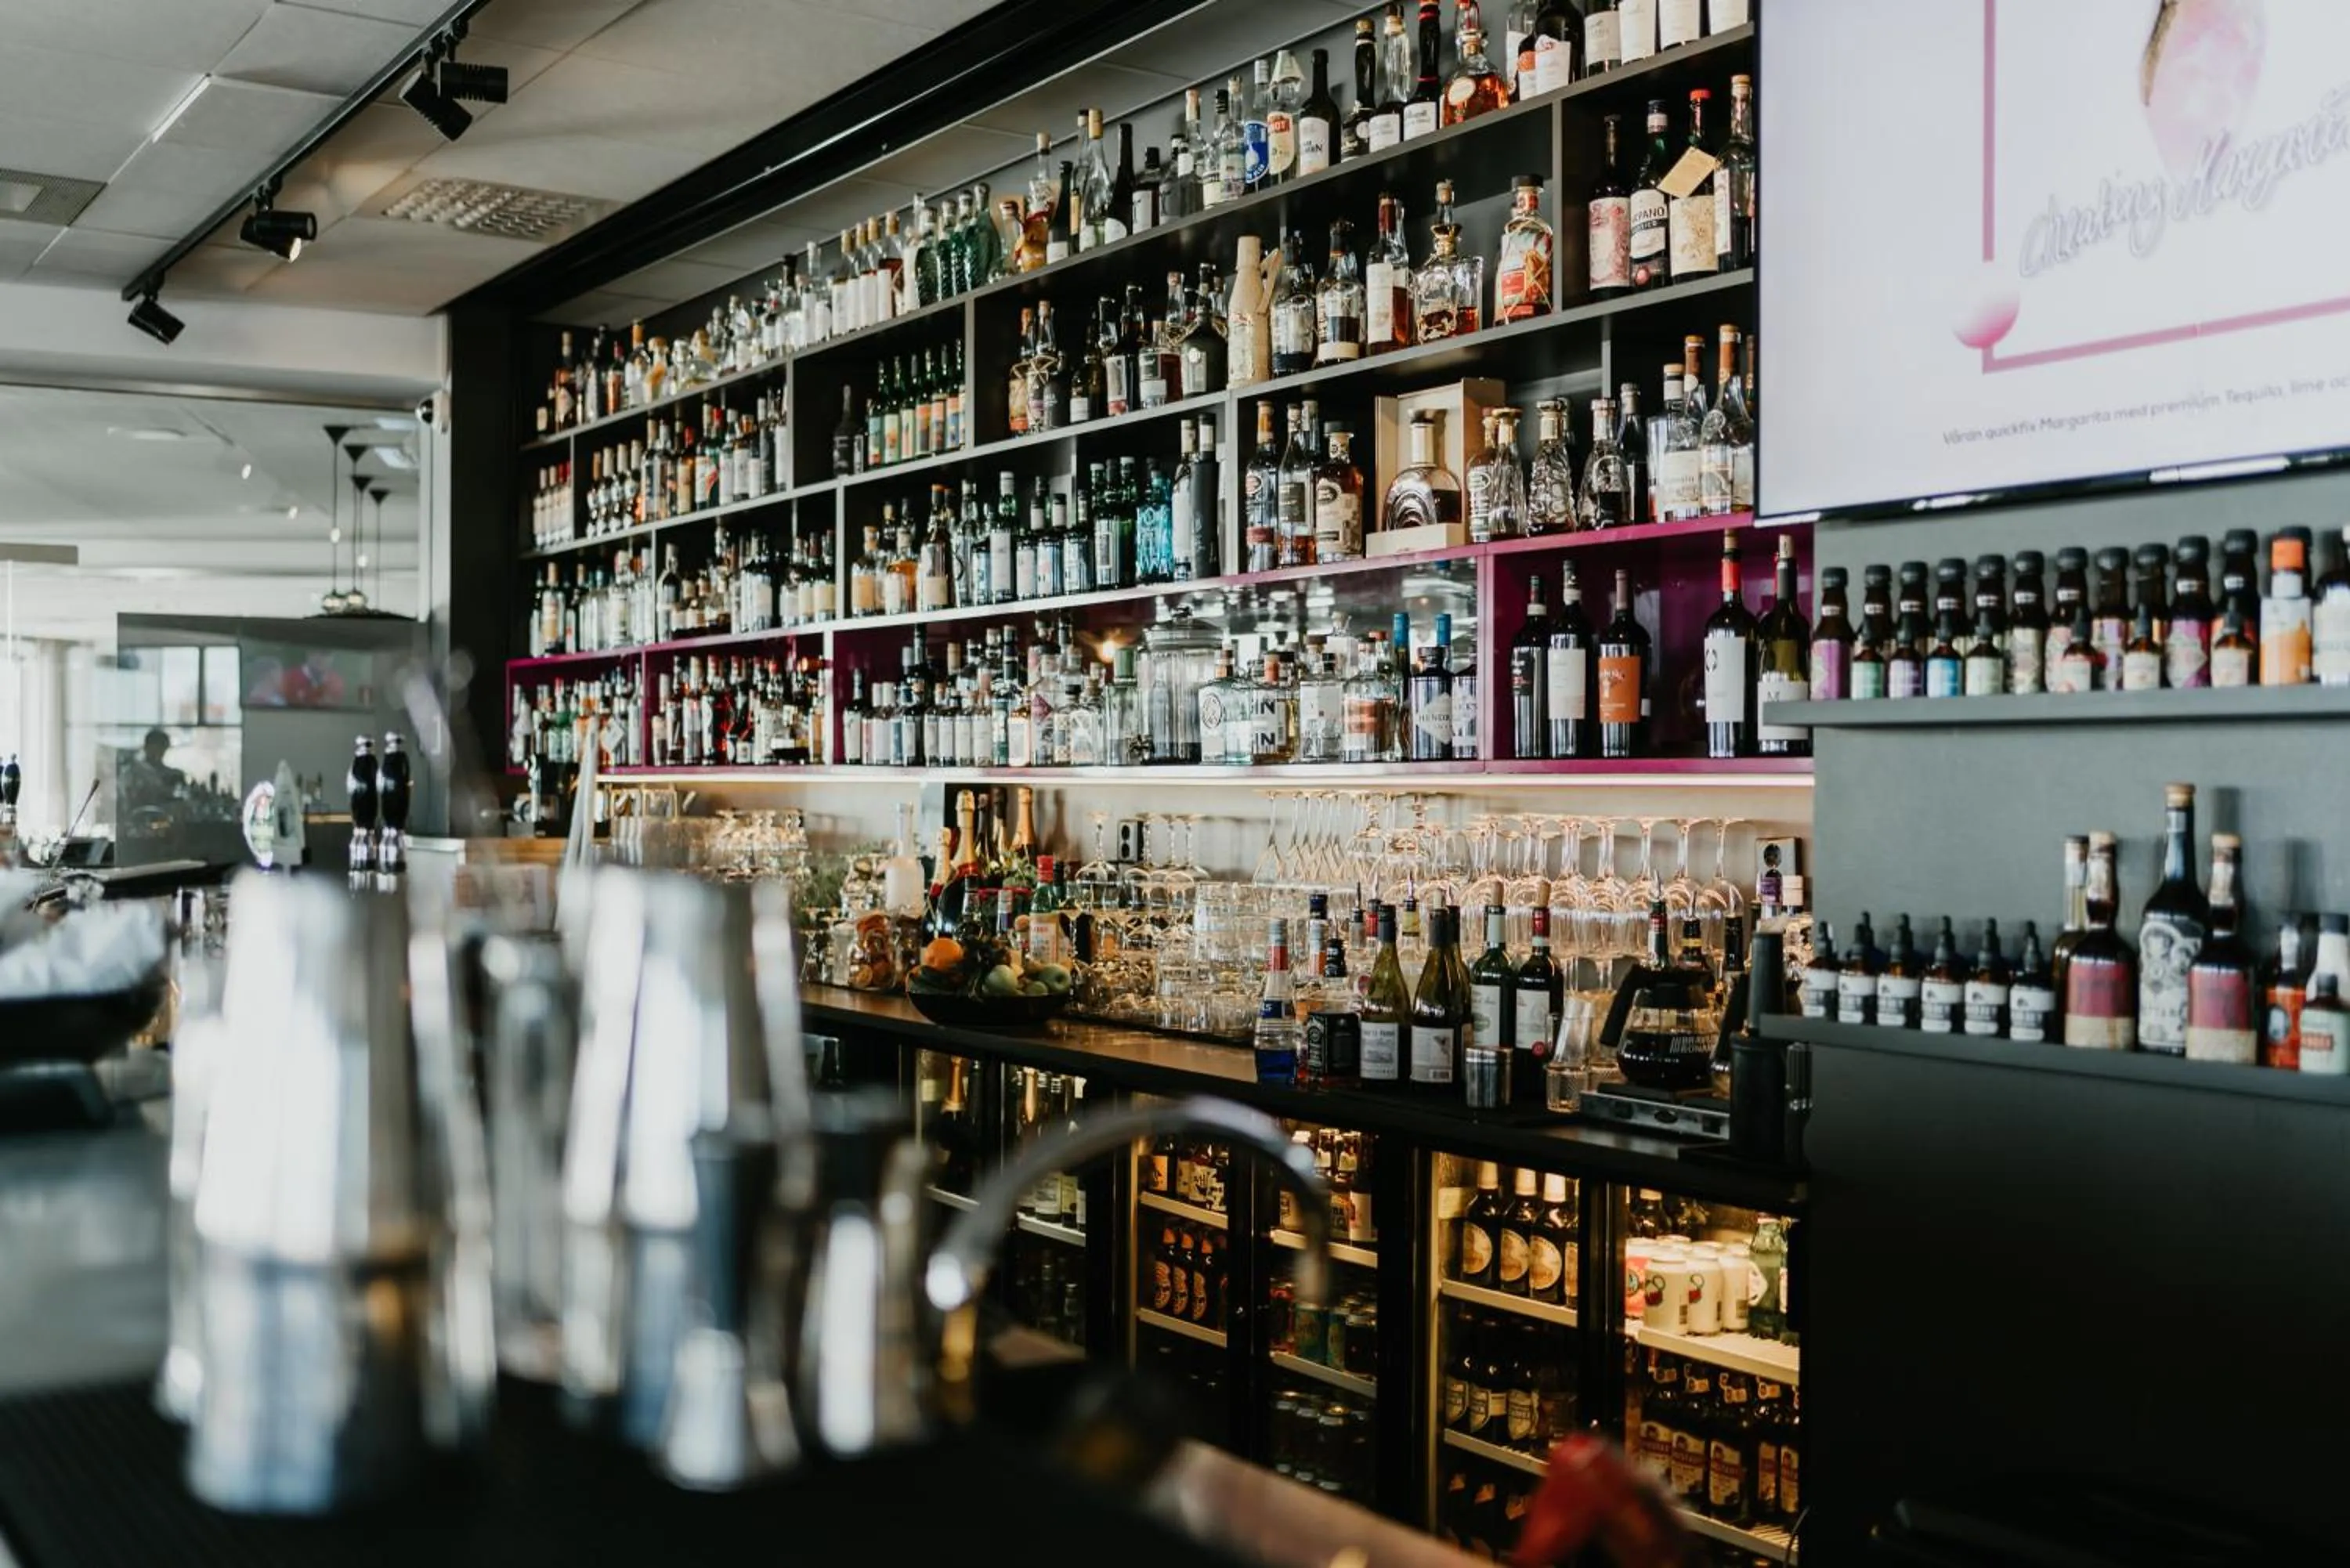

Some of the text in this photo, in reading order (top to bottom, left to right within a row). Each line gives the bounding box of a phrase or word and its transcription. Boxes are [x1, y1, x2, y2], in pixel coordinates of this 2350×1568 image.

[2039, 411, 2111, 432] Margarita
[2113, 404, 2147, 420] med
[2150, 394, 2220, 421] premium
[2289, 378, 2326, 395] lime
[1251, 699, 1275, 714] IN
[1251, 732, 1275, 746] IN
